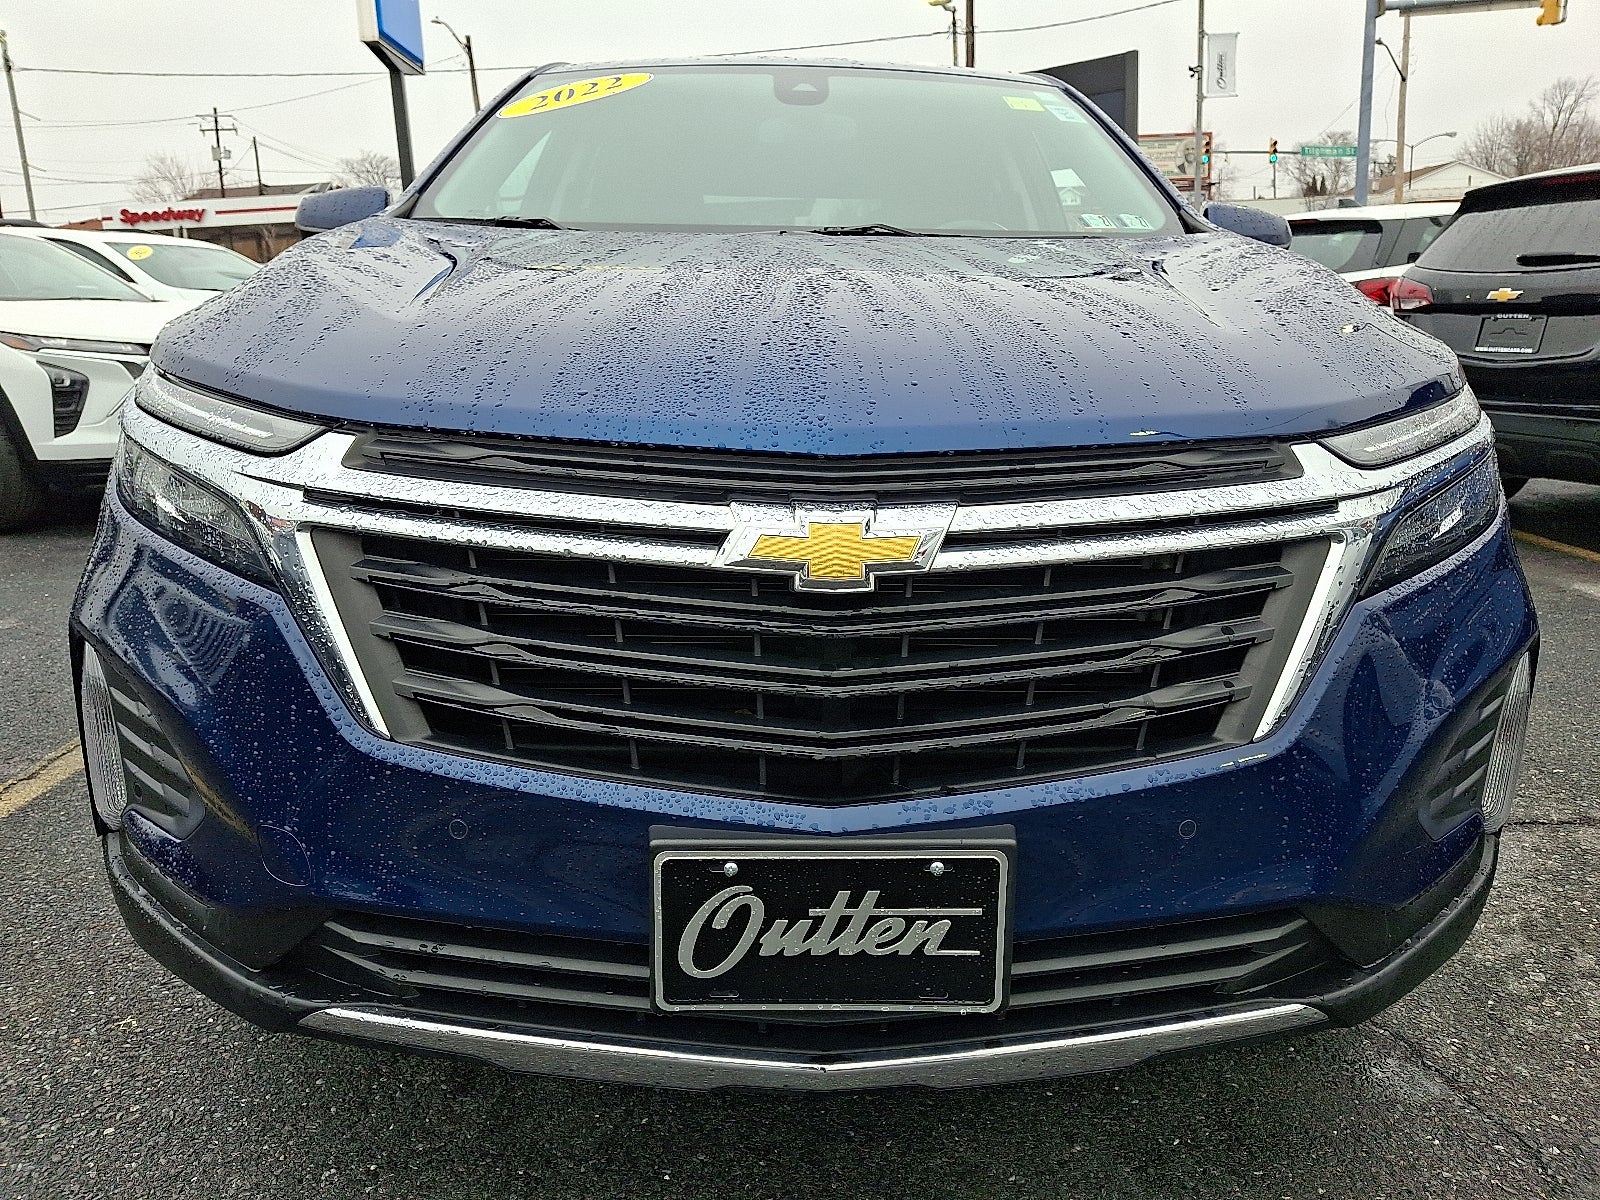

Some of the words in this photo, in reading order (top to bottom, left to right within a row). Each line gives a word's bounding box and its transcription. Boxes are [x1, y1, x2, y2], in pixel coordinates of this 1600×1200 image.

[531, 76, 623, 111] 2022
[1345, 147, 1356, 155] St
[120, 207, 206, 226] Speedway
[678, 885, 983, 979] Outten
